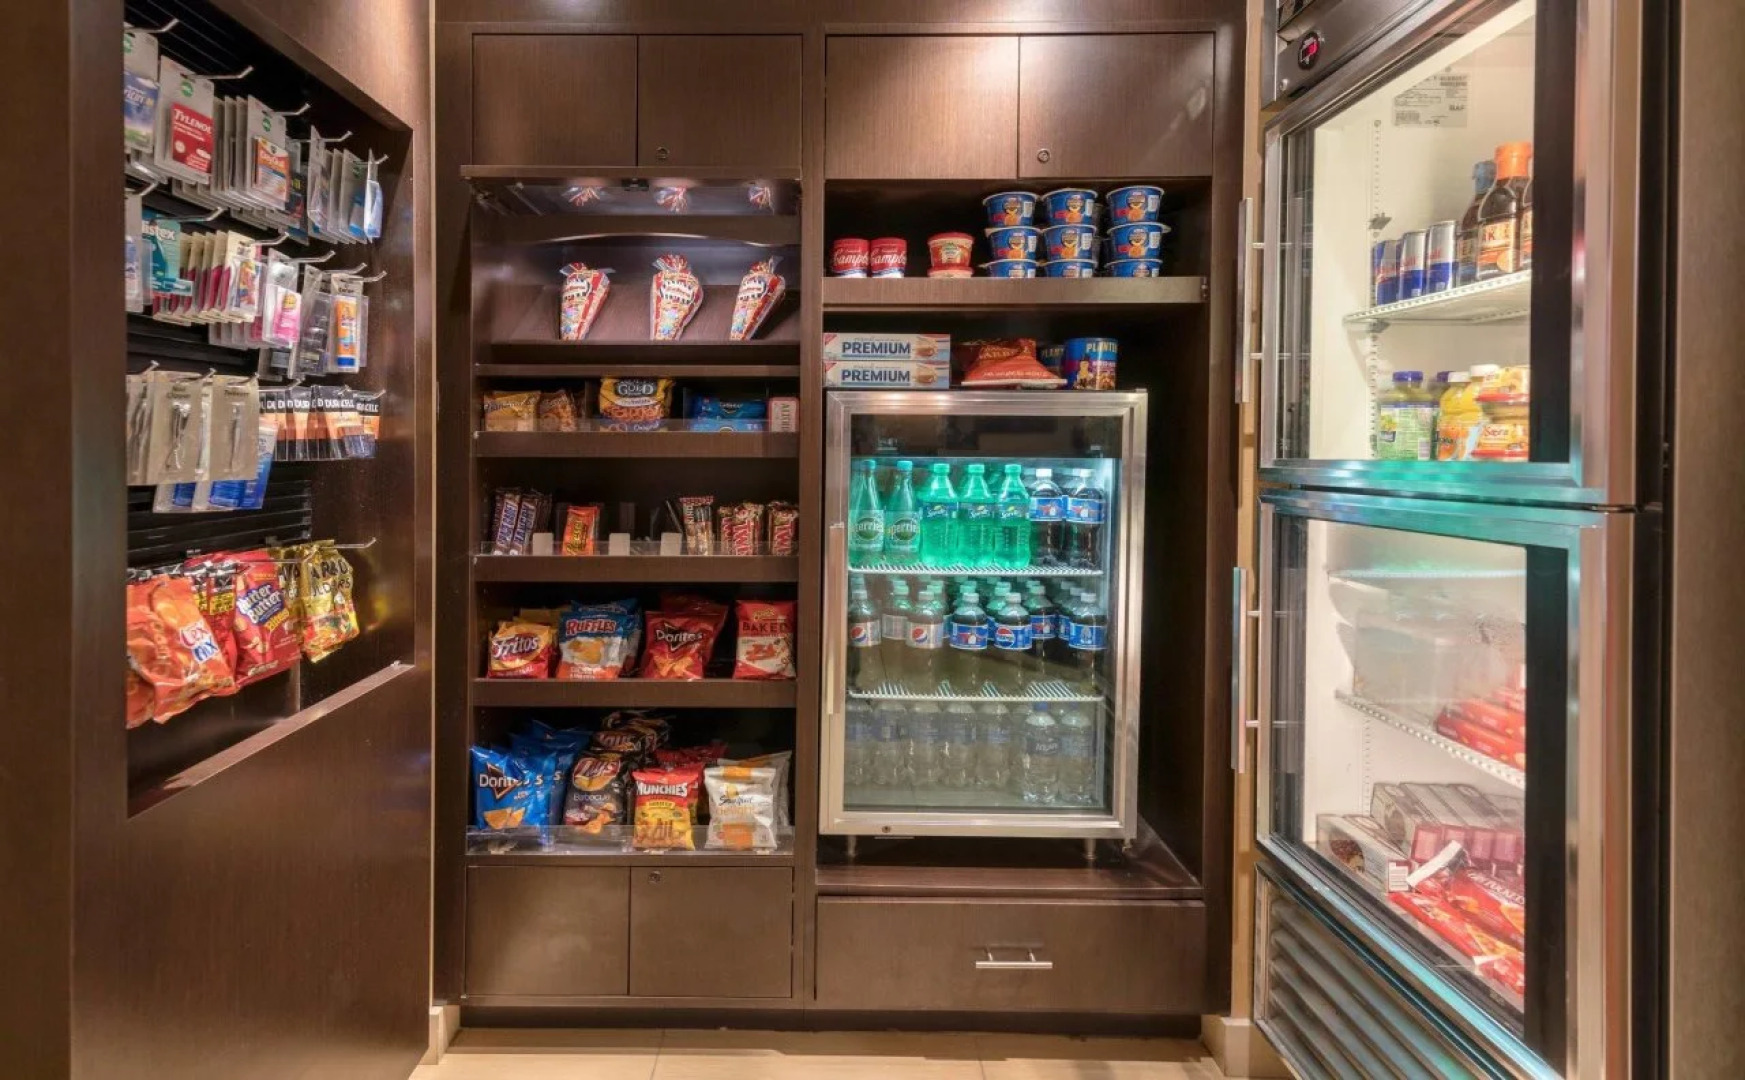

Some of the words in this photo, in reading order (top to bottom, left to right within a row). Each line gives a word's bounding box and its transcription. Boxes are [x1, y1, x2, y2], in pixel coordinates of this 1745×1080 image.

[174, 108, 212, 134] TYLENOL
[842, 341, 911, 354] PREMIUM
[841, 369, 910, 382] PREMIUM
[247, 592, 282, 624] Butter
[566, 618, 617, 636] RUFFLES
[743, 621, 788, 632] BAKED
[656, 628, 703, 642] Doritos
[492, 636, 540, 657] Fritos
[637, 780, 688, 796] MUNCHIES
